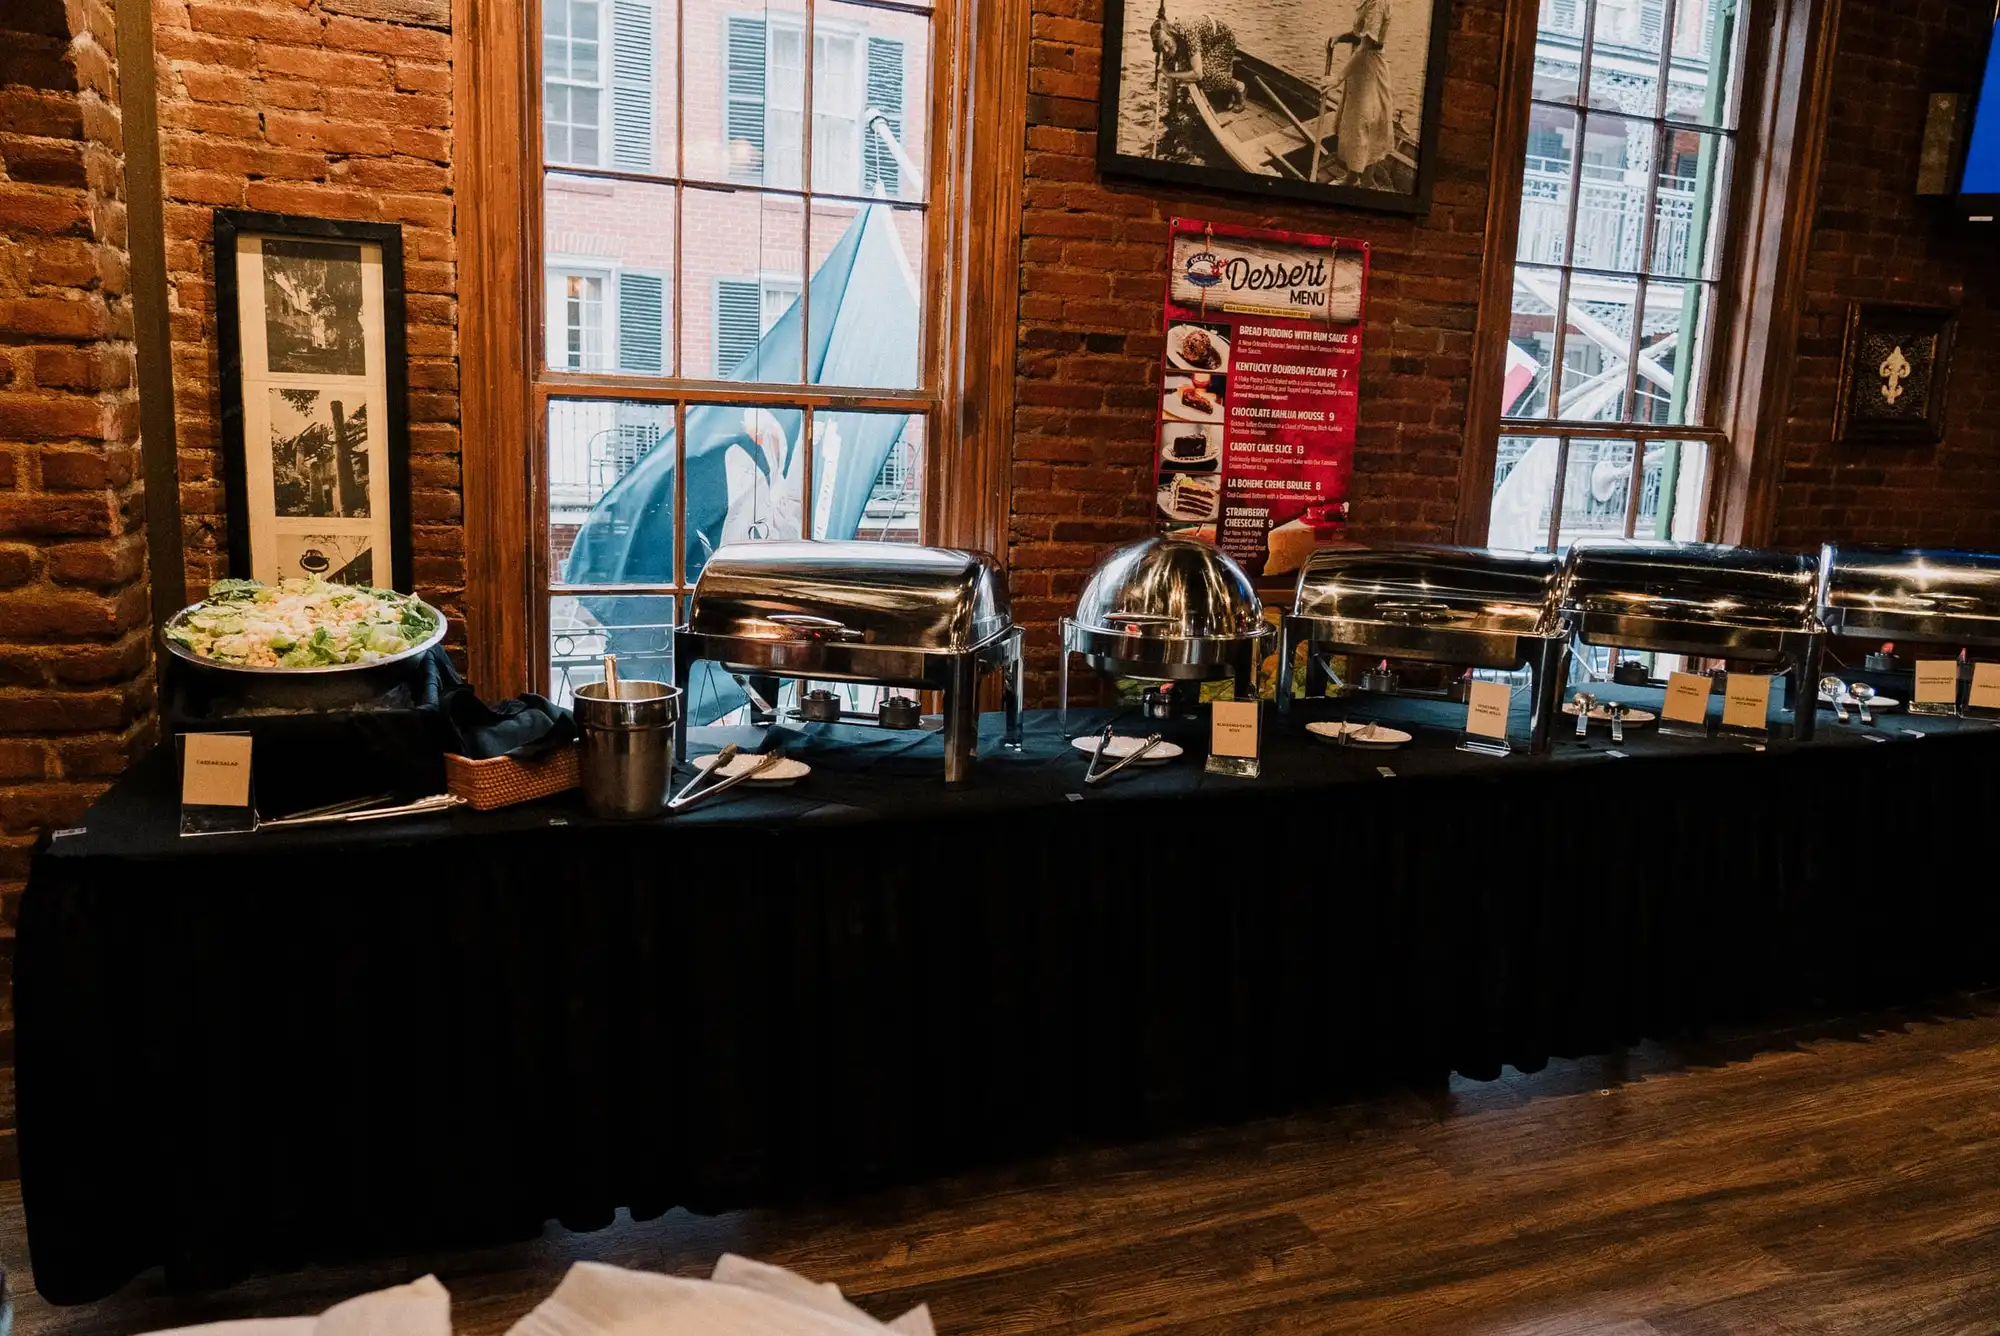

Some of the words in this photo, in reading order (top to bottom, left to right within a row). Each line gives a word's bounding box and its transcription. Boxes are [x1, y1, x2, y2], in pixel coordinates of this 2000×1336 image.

[1226, 257, 1326, 291] Dessert
[1290, 290, 1325, 306] MENU
[1240, 326, 1262, 336] BREAD
[1263, 328, 1293, 338] PUDDING
[1295, 330, 1312, 340] WITH
[1313, 332, 1328, 341] RUM
[1328, 333, 1348, 343] SAUCE
[1352, 335, 1358, 344] 8
[1235, 362, 1272, 373] KENTUCKY
[1273, 364, 1305, 375] BOURBON
[1306, 367, 1326, 377] PECAN
[1327, 369, 1338, 377] PIE
[1342, 370, 1347, 378] 7
[1232, 407, 1270, 418] CHOCOLATE
[1271, 409, 1296, 419] KAHLUA
[1298, 411, 1324, 421] MOUSSE
[1329, 412, 1335, 421] 9
[1230, 442, 1255, 452] CARROT
[1257, 443, 1273, 452] CAKE
[1275, 445, 1292, 454] SLICE
[1297, 446, 1304, 454] 13
[1227, 479, 1236, 488] LA
[1238, 479, 1263, 489] BOHEME
[1264, 481, 1286, 490] CREME
[1286, 481, 1311, 490] BRULEE
[1316, 482, 1321, 490] 8
[1226, 507, 1269, 517] STRAWBERRY
[1225, 519, 1264, 528] CHEESECAKE
[1268, 520, 1273, 528] 9
